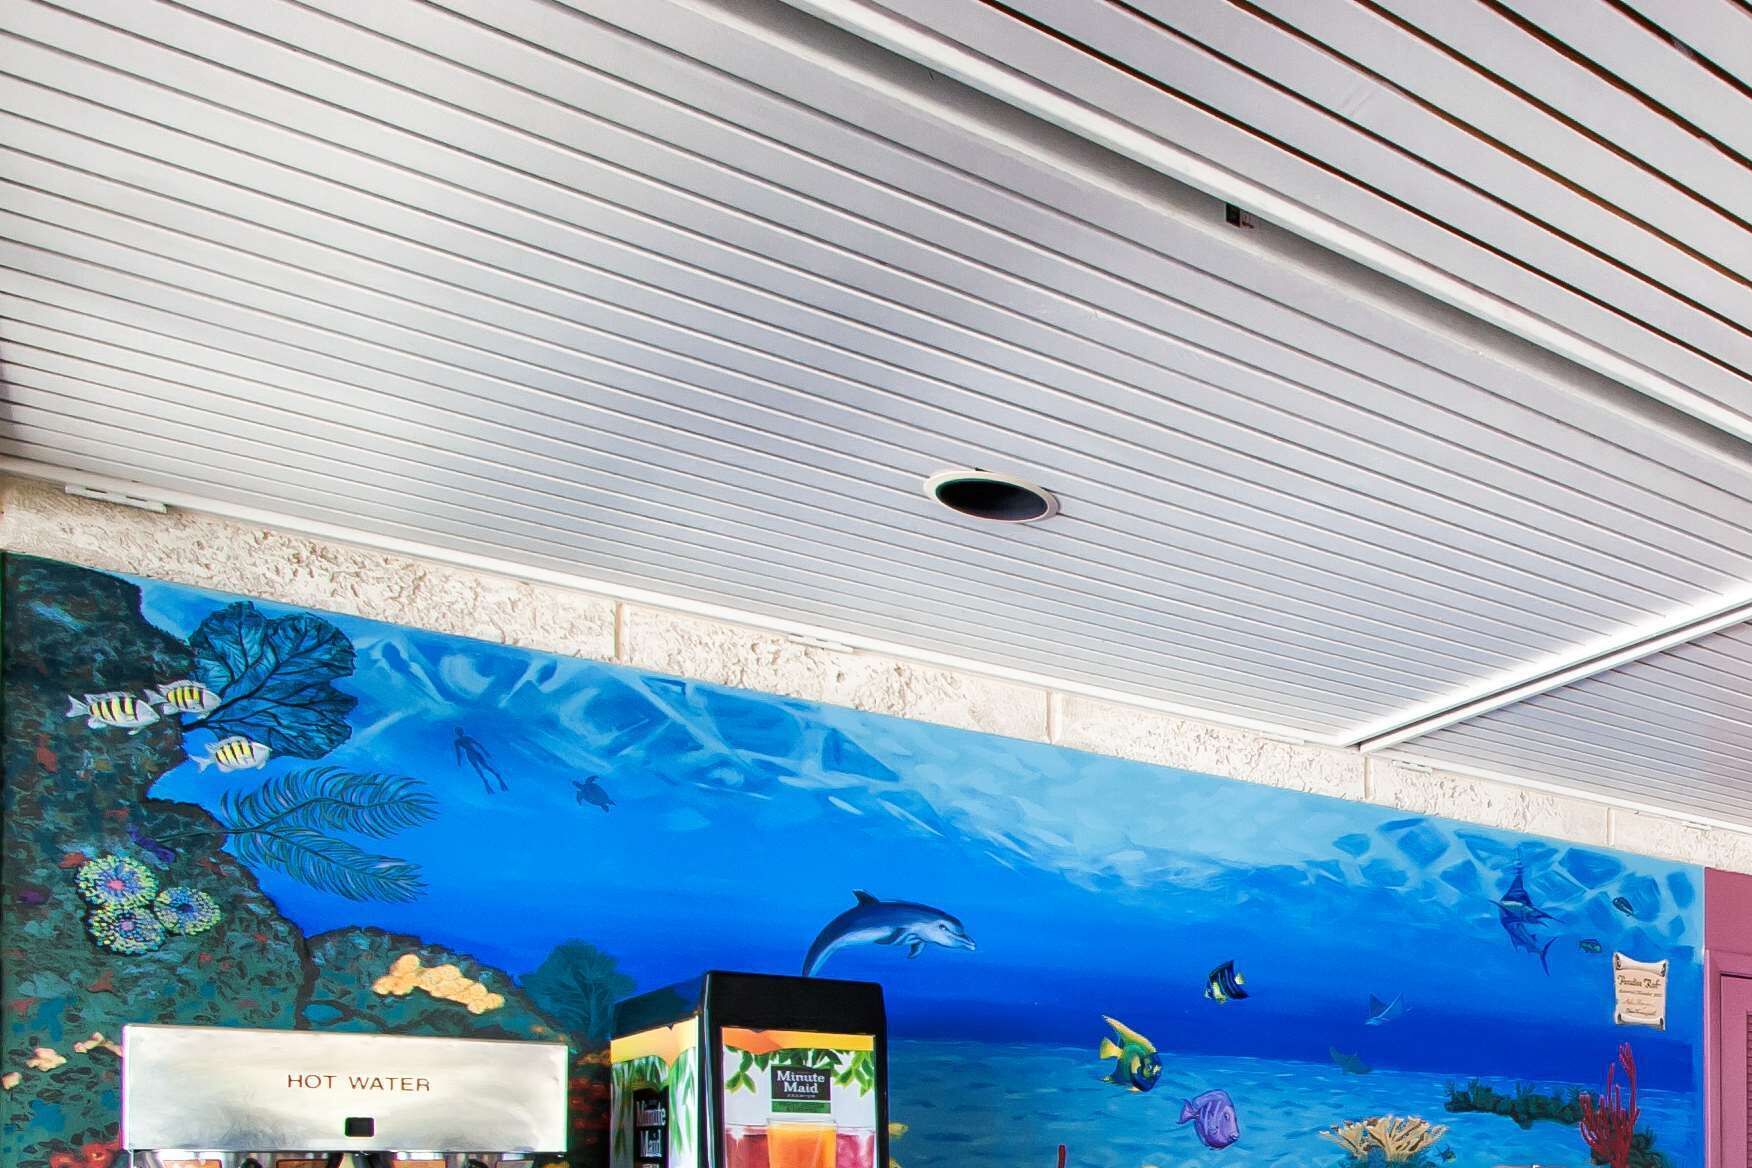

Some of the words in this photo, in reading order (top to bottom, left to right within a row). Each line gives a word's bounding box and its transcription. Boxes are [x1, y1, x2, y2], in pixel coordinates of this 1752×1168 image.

[287, 1074, 337, 1089] HOT
[348, 1075, 430, 1092] WATER
[776, 1070, 825, 1083] Minute
[784, 1081, 818, 1094] Maid
